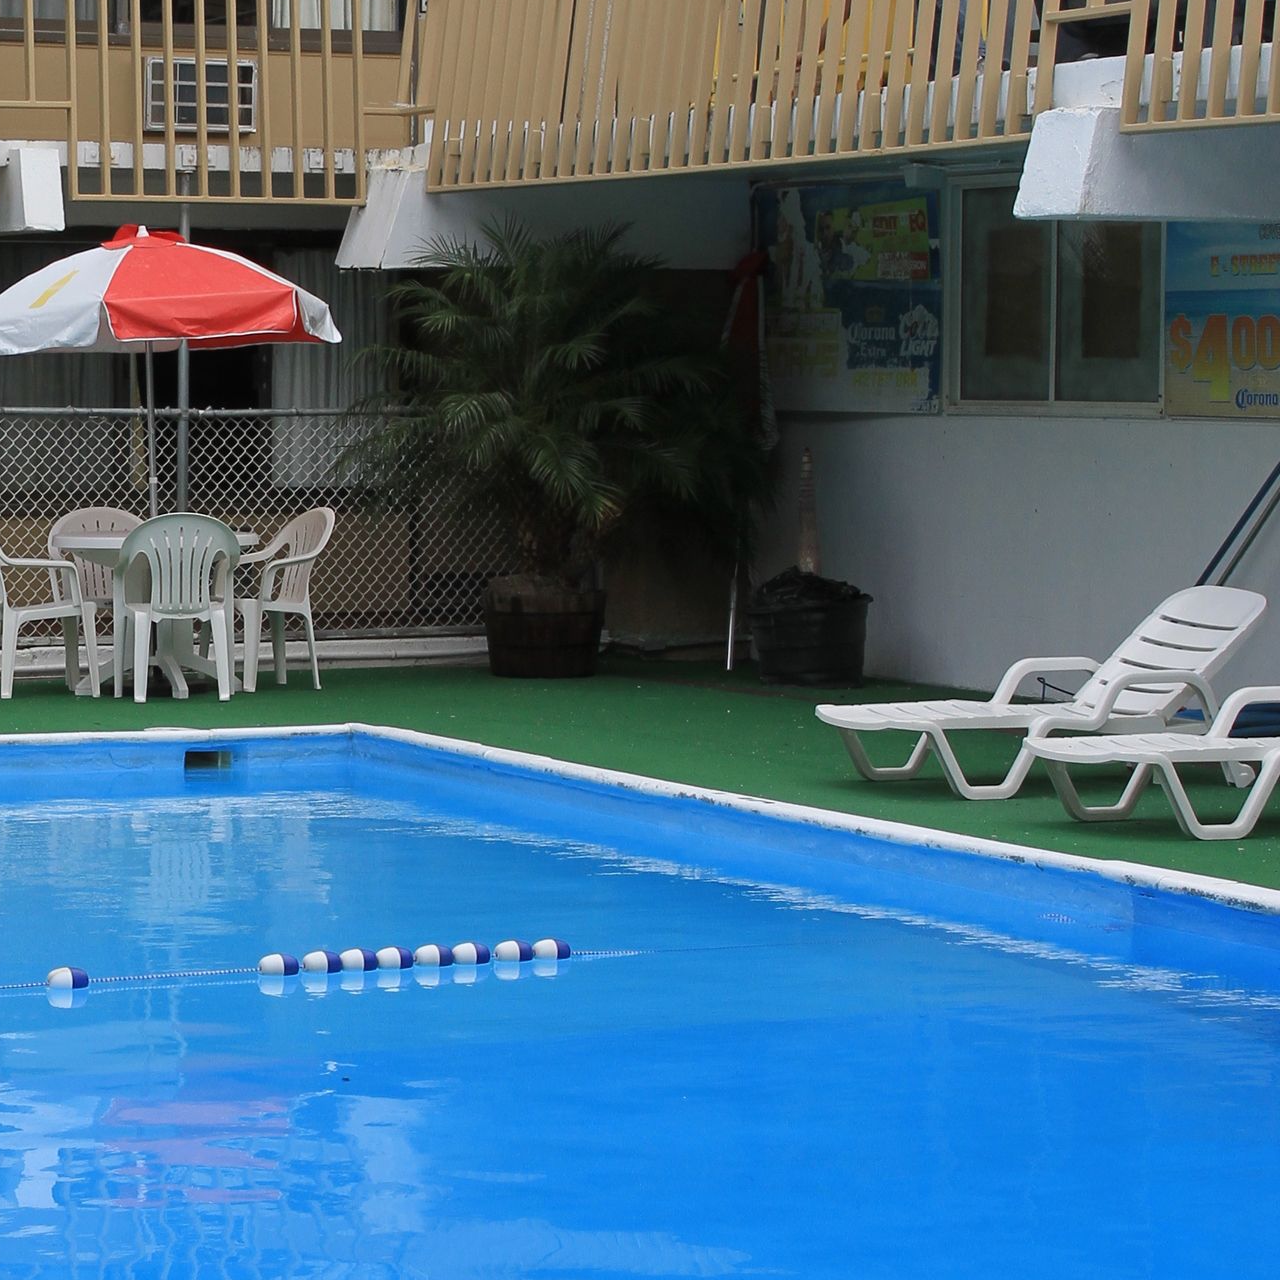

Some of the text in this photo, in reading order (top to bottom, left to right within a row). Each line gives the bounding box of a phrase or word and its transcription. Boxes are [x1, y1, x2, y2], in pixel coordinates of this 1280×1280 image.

[848, 322, 896, 344] Corona
[900, 339, 937, 357] LIGHT
[1235, 388, 1279, 410] Corona
